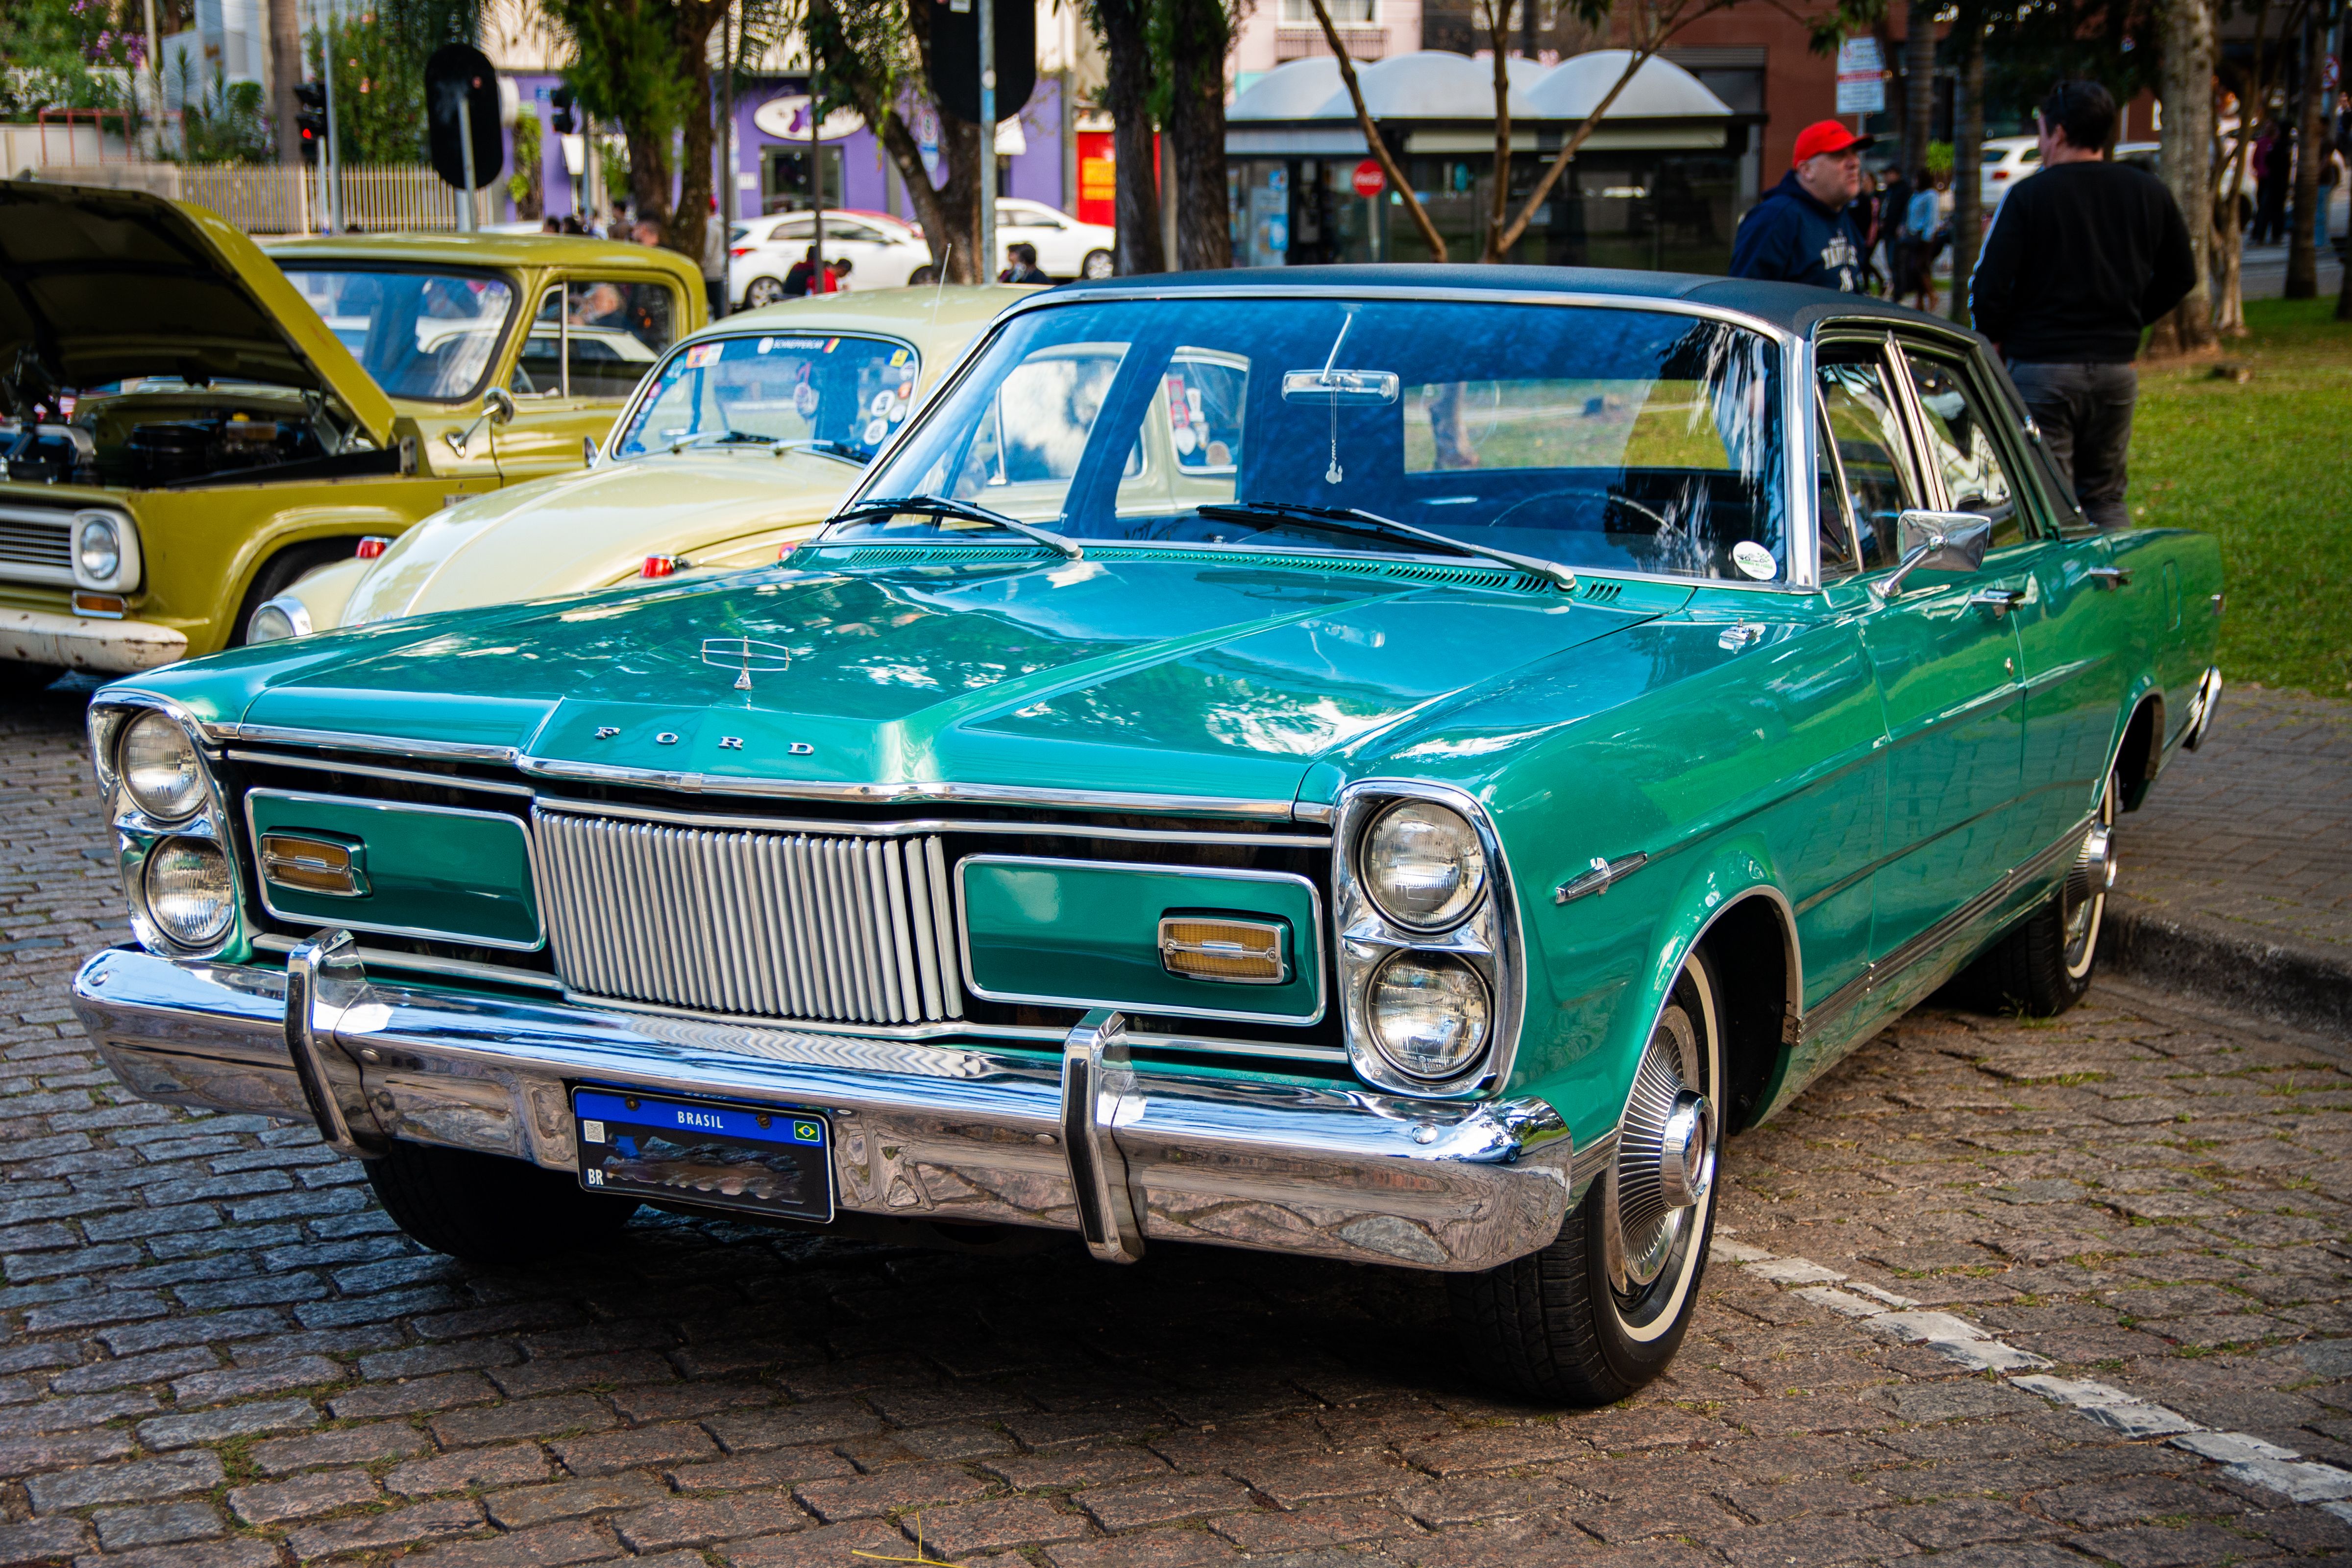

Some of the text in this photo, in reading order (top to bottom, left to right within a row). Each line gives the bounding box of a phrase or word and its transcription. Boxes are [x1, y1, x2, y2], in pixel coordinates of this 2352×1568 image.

[595, 727, 814, 756] FORD
[677, 1111, 724, 1128] BRASIL
[588, 1168, 604, 1186] BR
